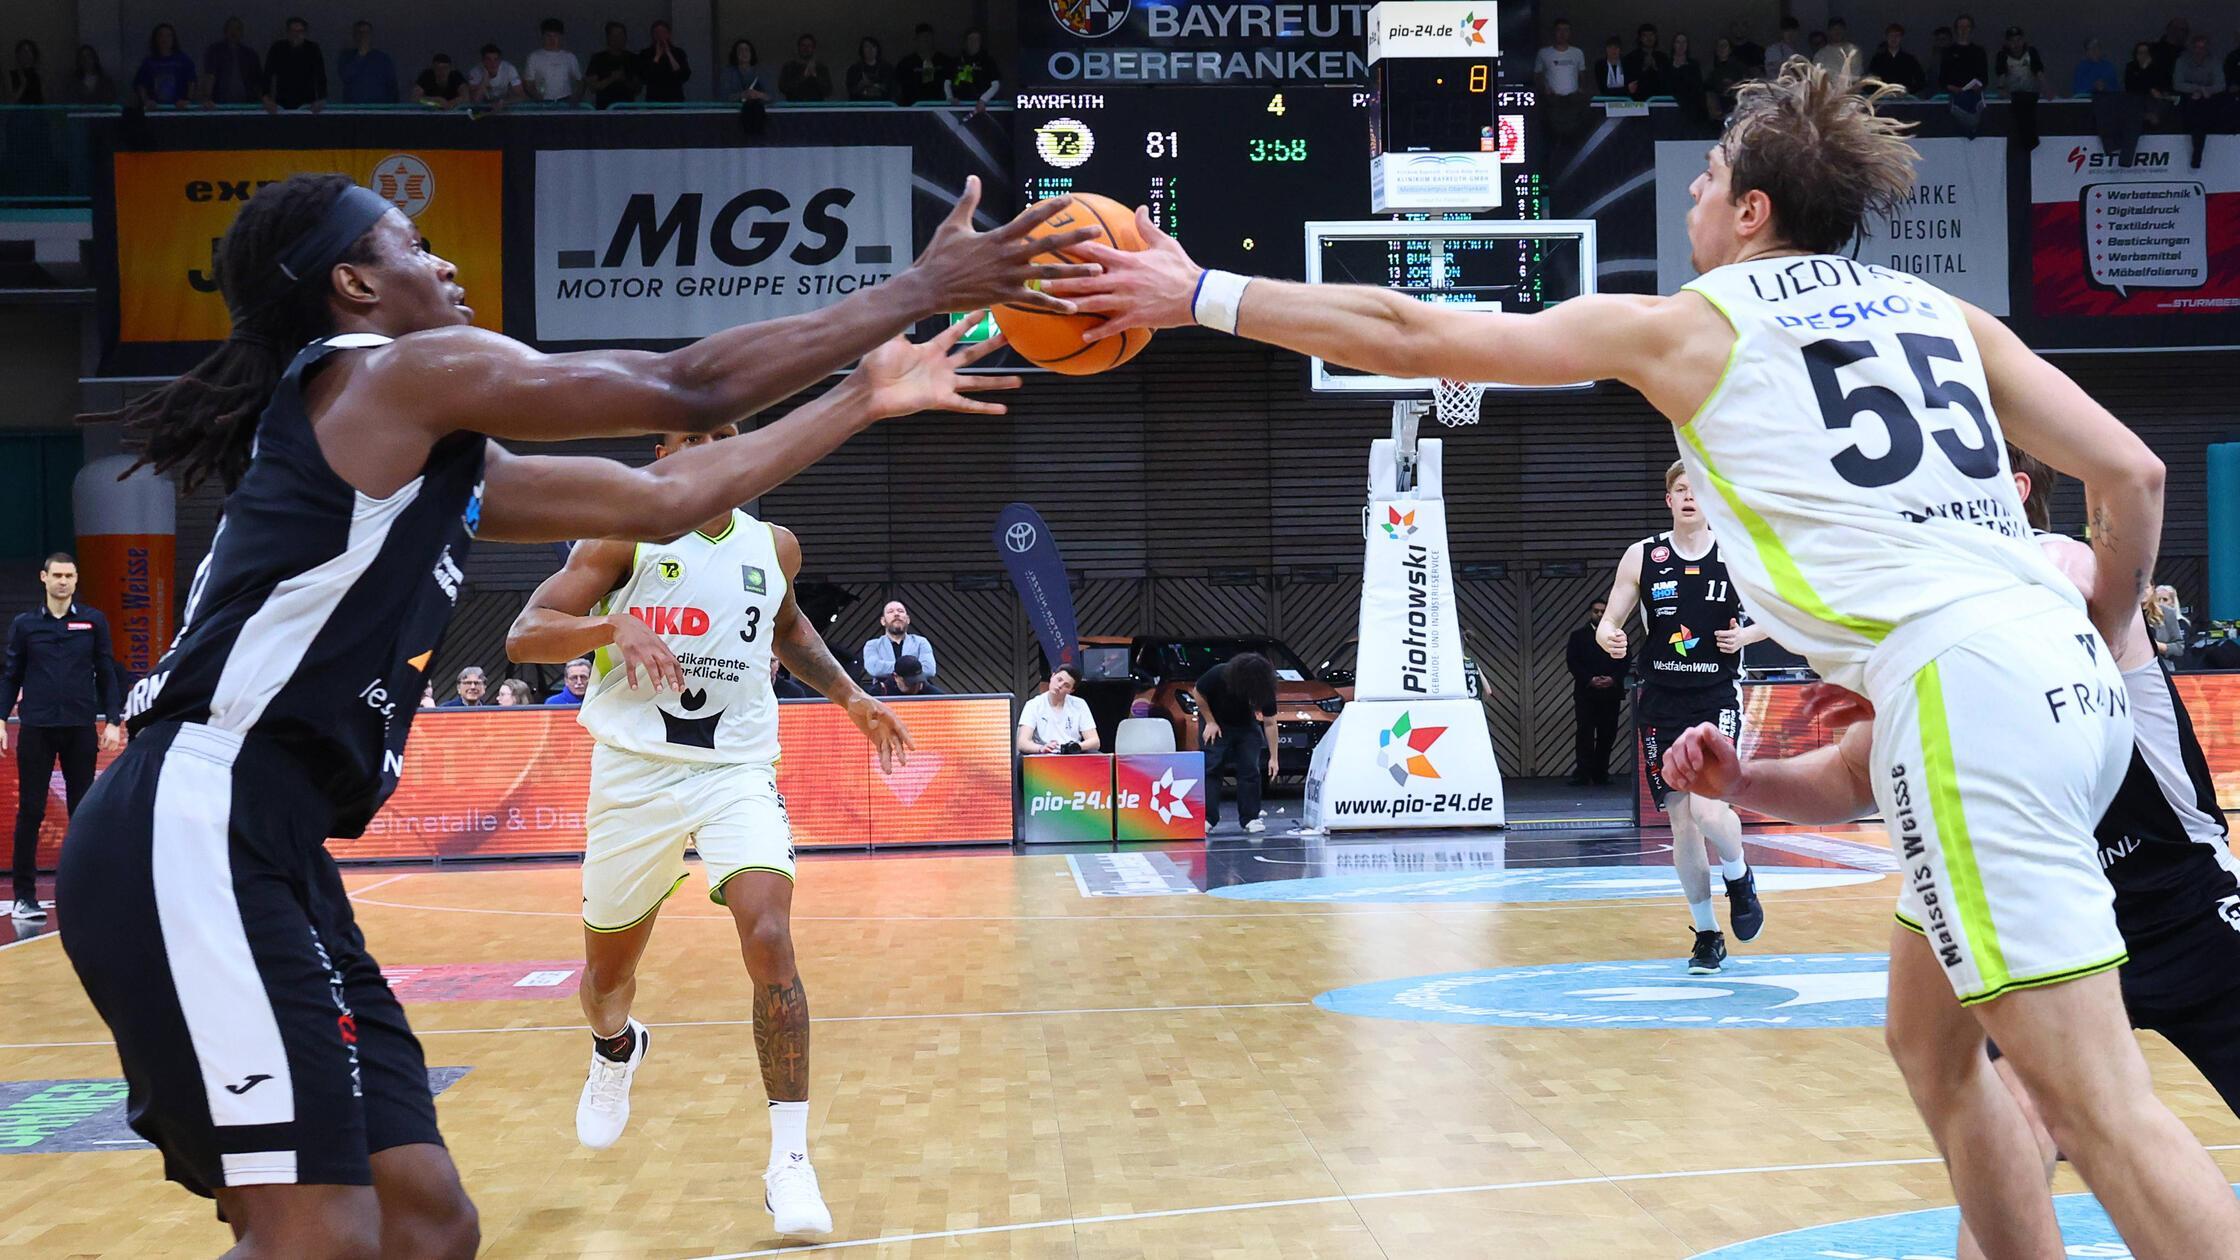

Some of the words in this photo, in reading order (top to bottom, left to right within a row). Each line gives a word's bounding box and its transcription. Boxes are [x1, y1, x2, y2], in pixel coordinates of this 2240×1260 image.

[1147, 3, 1369, 38] BAYREUT
[1388, 24, 1453, 41] pio-24.de
[1469, 65, 1488, 93] 8
[1016, 94, 1105, 109] BAYREUTH
[1266, 93, 1286, 117] 4
[1145, 131, 1178, 158] 81
[1249, 139, 1308, 162] 3:58
[2088, 152, 2170, 168] STRM
[2107, 189, 2192, 200] Werbetechnik
[2107, 205, 2181, 217] Digitaldruck
[601, 188, 856, 268] MGS
[1890, 219, 1962, 239] DESIGN
[2108, 220, 2176, 231] Textildruck
[2107, 236, 2190, 248] Bestickungen
[1890, 253, 1967, 274] DIGITAL
[2108, 250, 2182, 262] Werbemittel
[2107, 266, 2198, 278] Möbelfolierung
[557, 277, 664, 300] MOTOR
[675, 275, 786, 297] GRUPPE
[1800, 331, 2001, 489] 55
[121, 547, 151, 610] Weisse
[1704, 579, 1728, 602] 11
[739, 605, 761, 643] 3
[1401, 544, 1427, 694] Piotrowski
[1431, 630, 1440, 648] UND
[1653, 660, 1720, 673] WestfalenWIND
[1335, 793, 1494, 818] www.pio-24.de
[1890, 763, 1926, 860] Weisse
[506, 808, 527, 831] &
[1912, 865, 1963, 968] Maisel's
